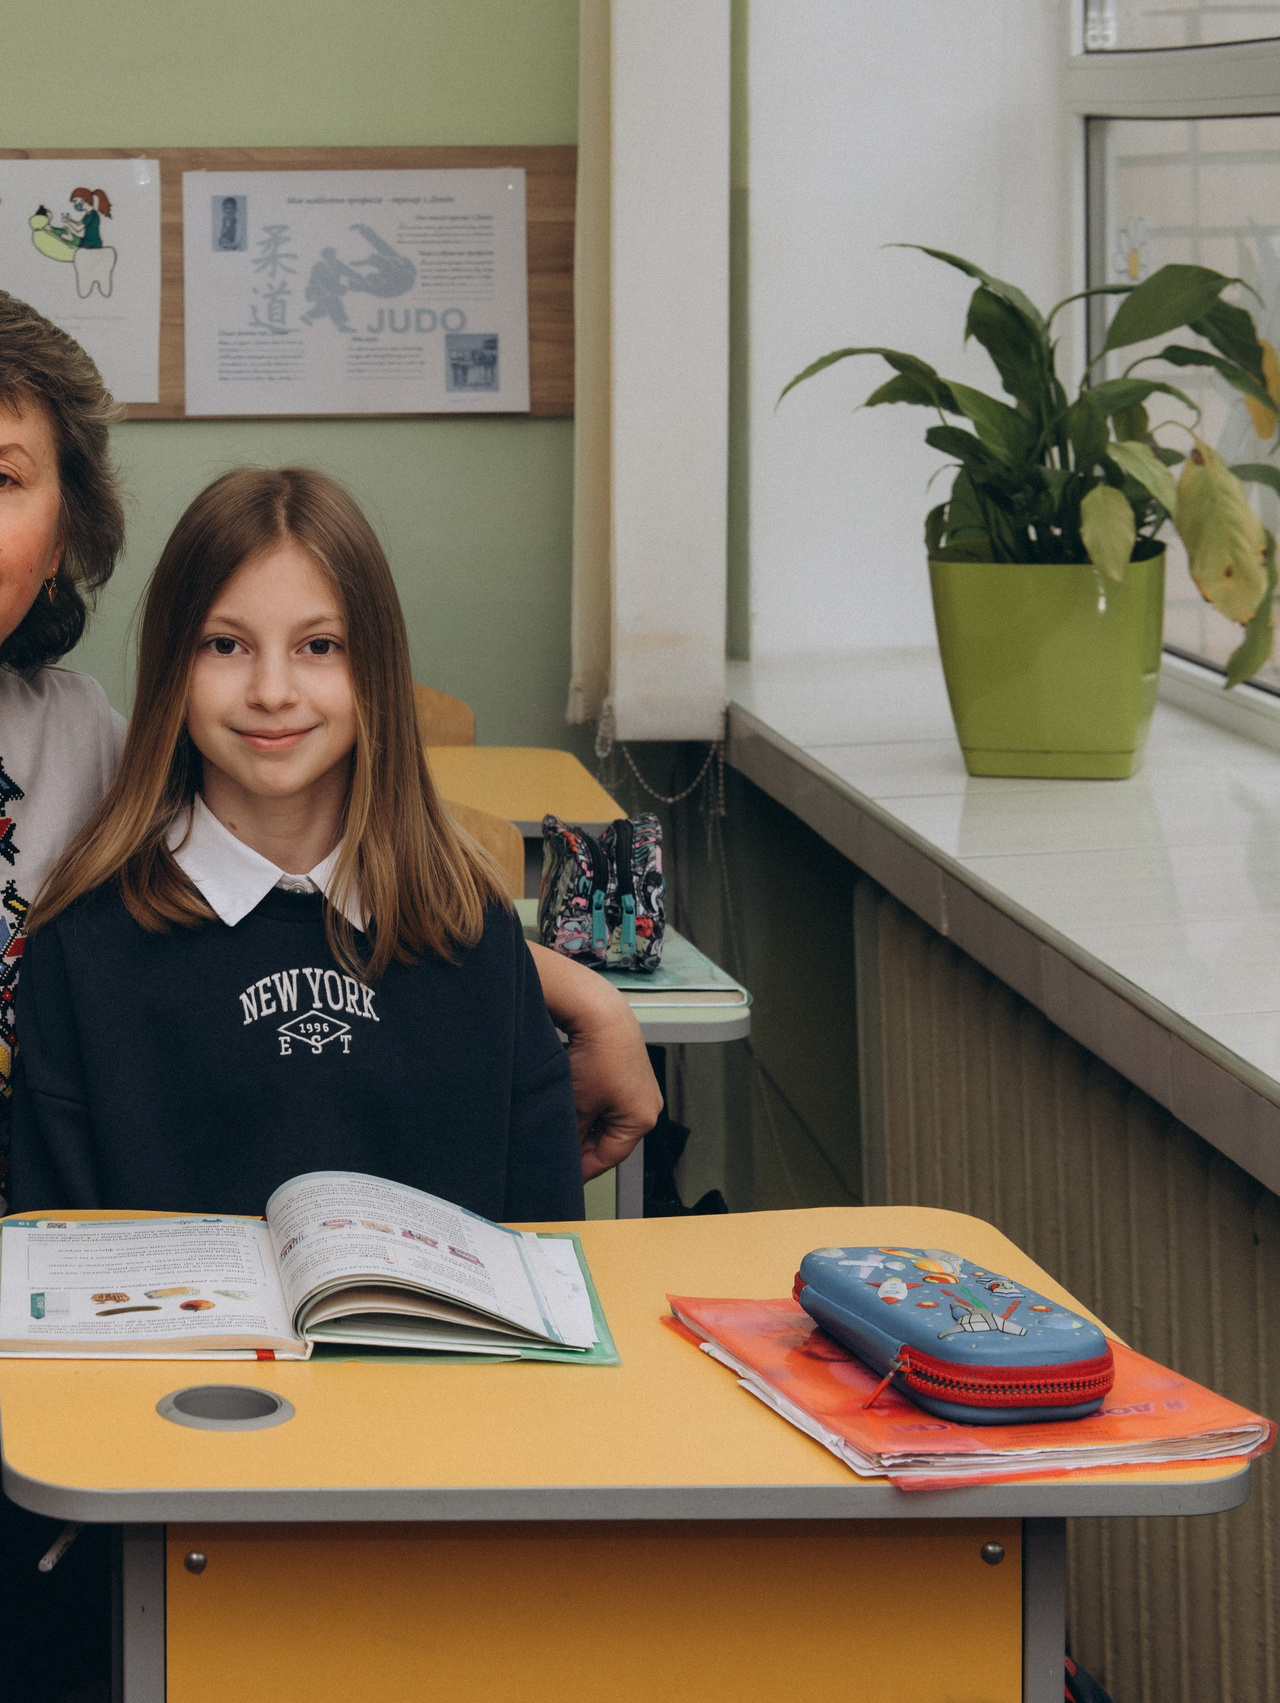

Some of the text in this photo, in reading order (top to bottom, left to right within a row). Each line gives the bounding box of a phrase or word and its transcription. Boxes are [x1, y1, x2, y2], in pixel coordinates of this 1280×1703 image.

[248, 222, 300, 335] 柔道
[366, 307, 467, 334] JUDO
[239, 967, 380, 1025] NEW YORK
[298, 1022, 330, 1034] 1996
